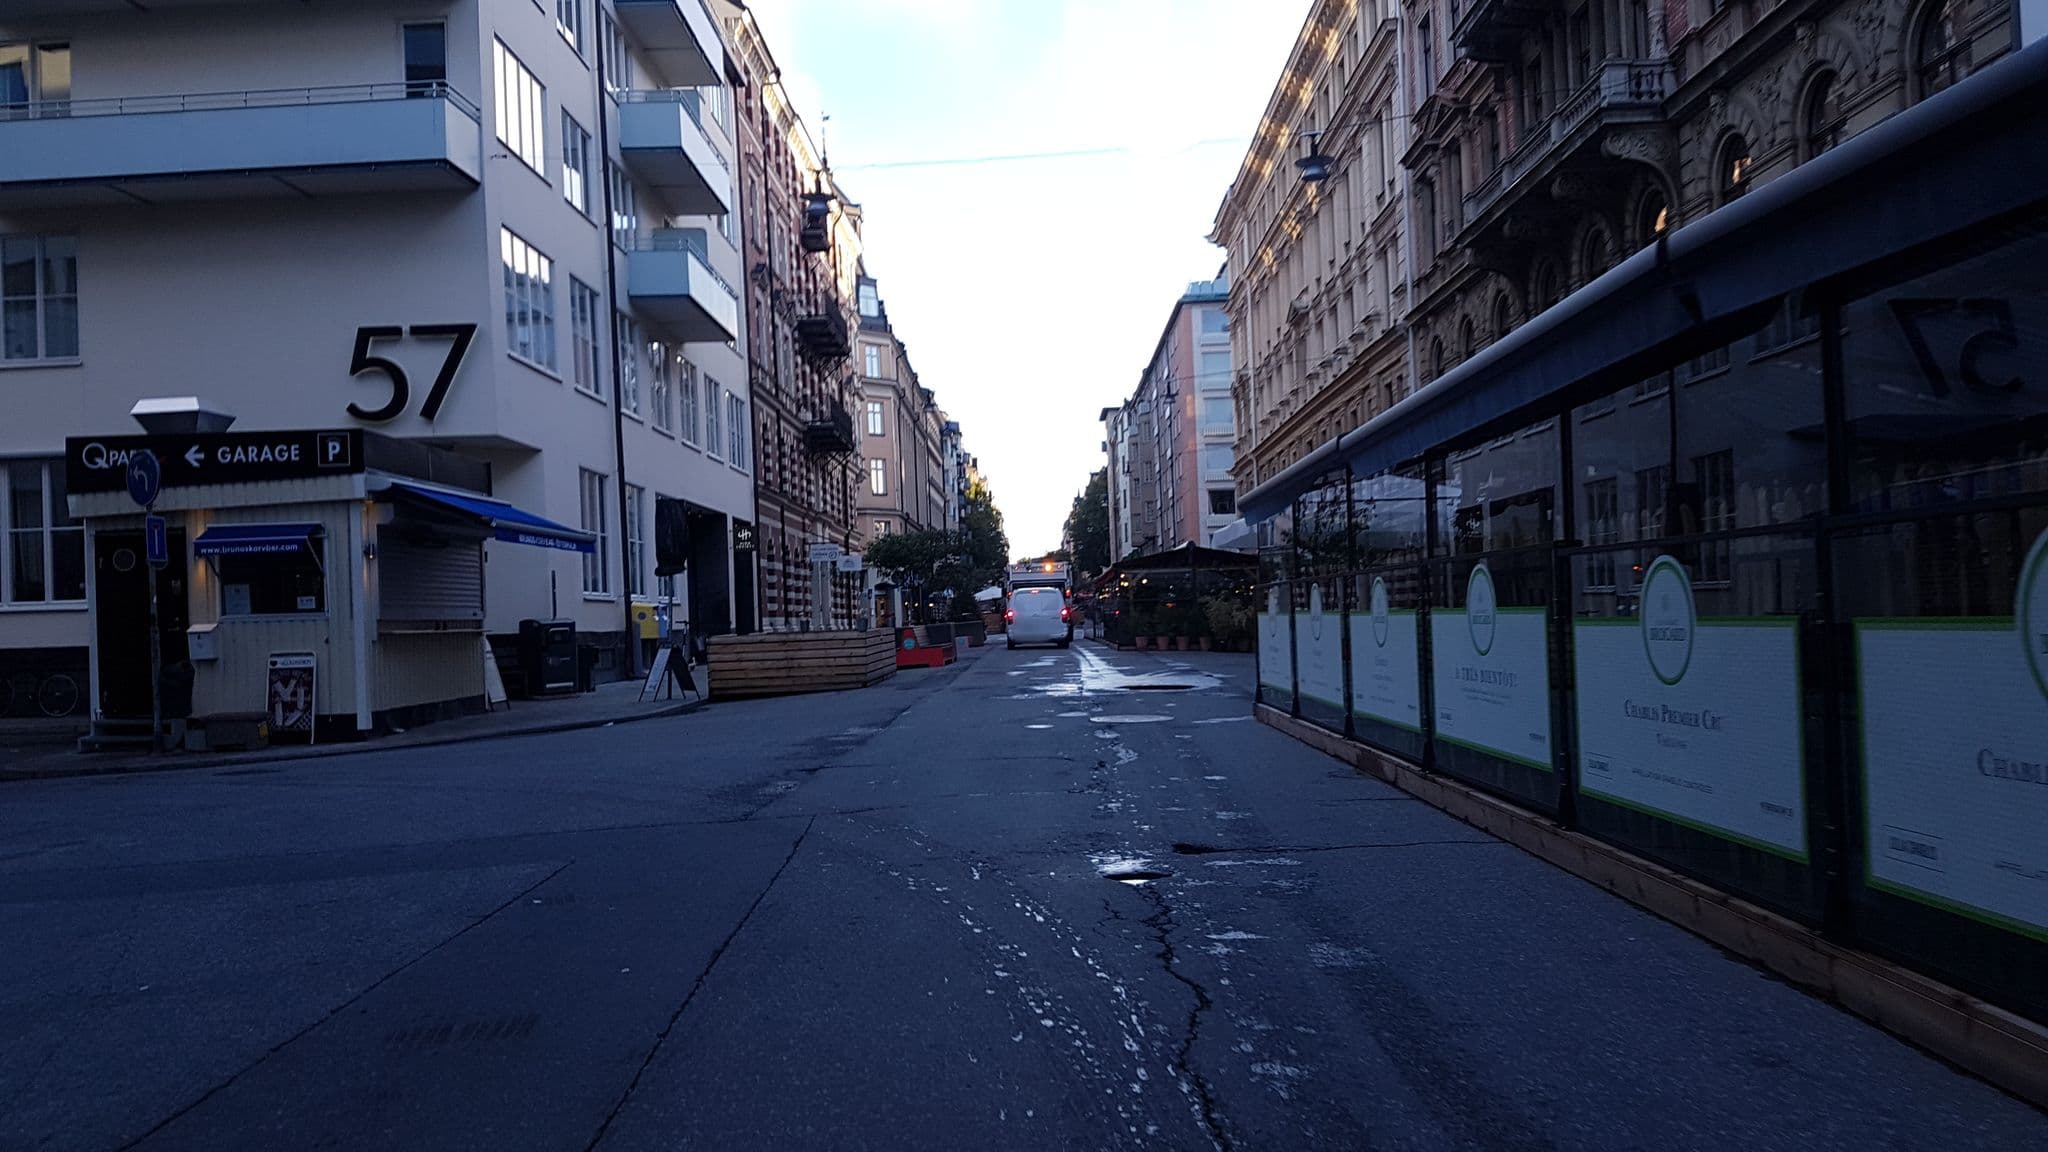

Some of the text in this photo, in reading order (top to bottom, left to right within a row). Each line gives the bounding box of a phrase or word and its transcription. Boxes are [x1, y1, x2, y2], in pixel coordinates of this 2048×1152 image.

[346, 324, 477, 421] 57
[216, 443, 300, 464] GARAGE
[327, 440, 341, 462] P
